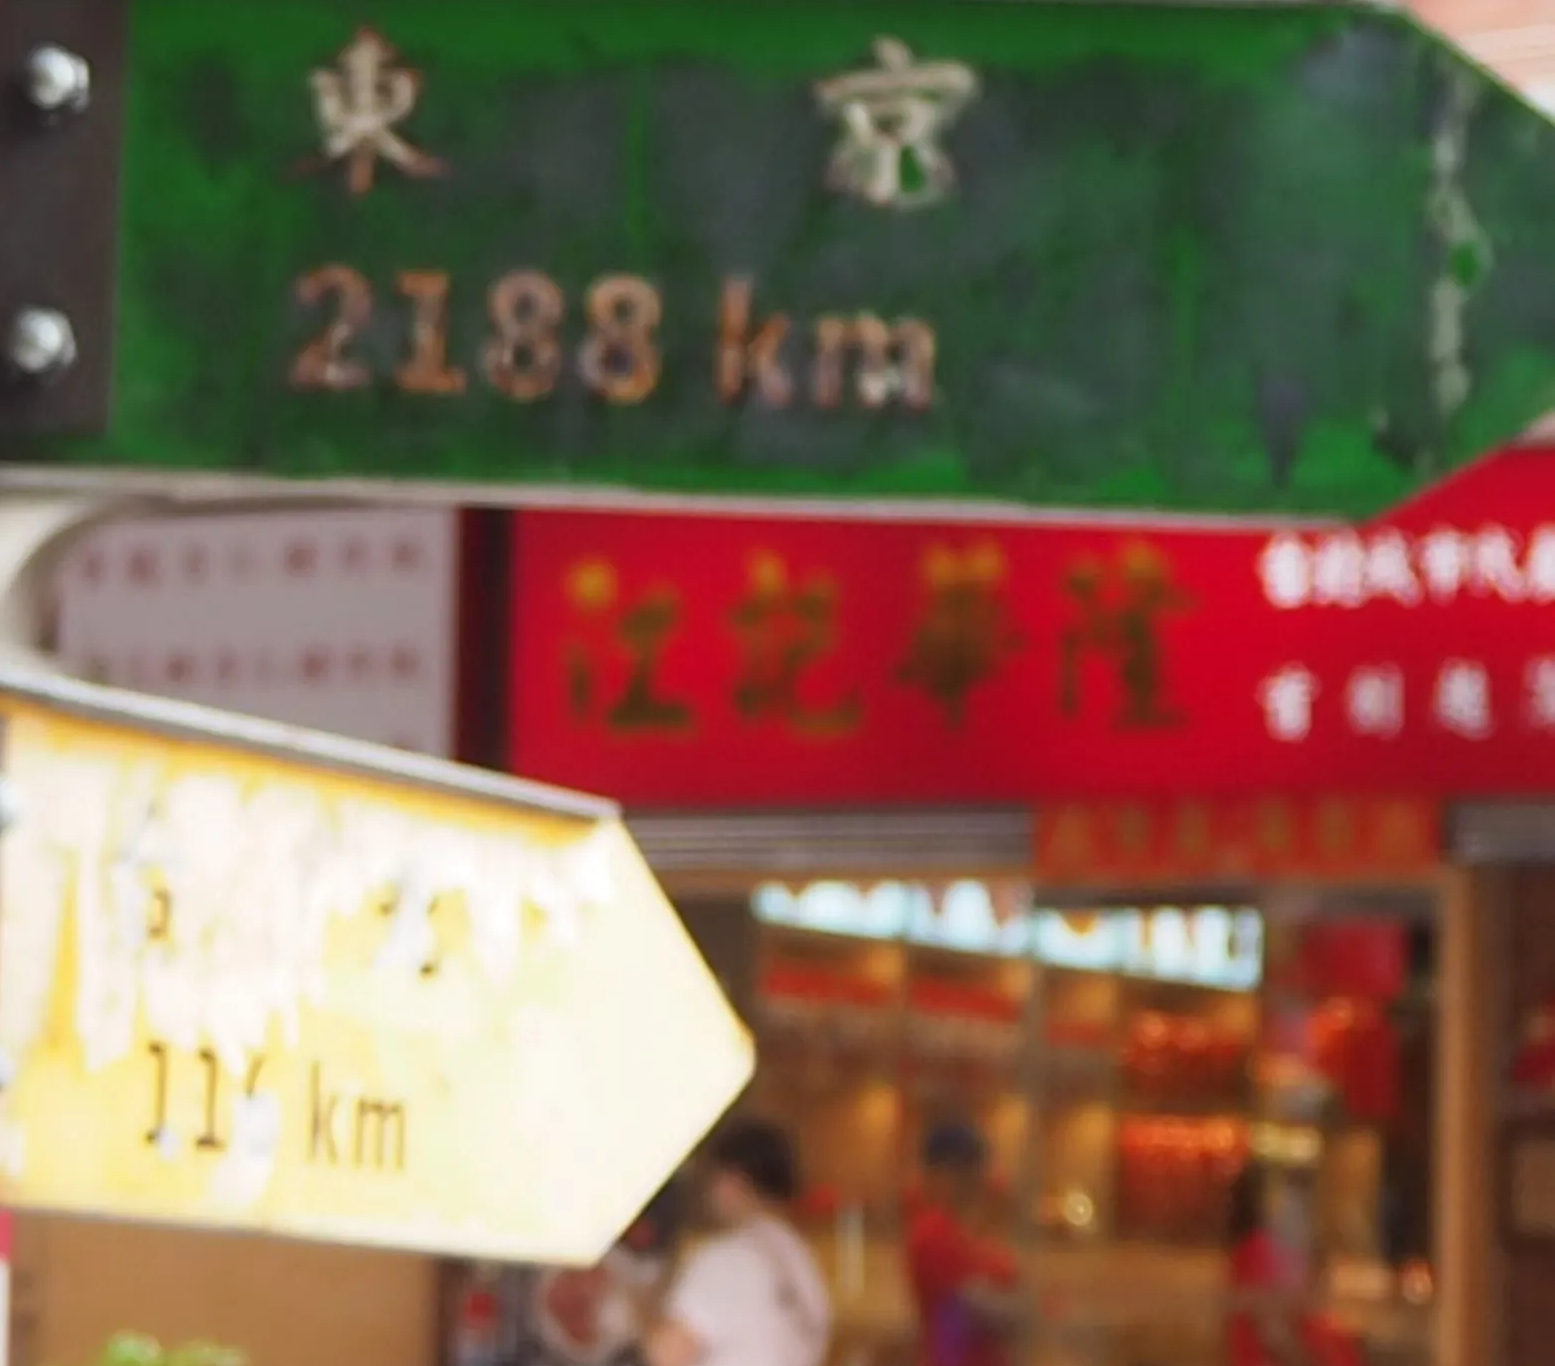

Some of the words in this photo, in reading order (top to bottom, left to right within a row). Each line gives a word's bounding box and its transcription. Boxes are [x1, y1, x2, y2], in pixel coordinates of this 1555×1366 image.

[296, 24, 981, 211] 東京
[288, 263, 665, 405] 2188
[714, 273, 940, 412] km
[307, 1059, 408, 1178] km
